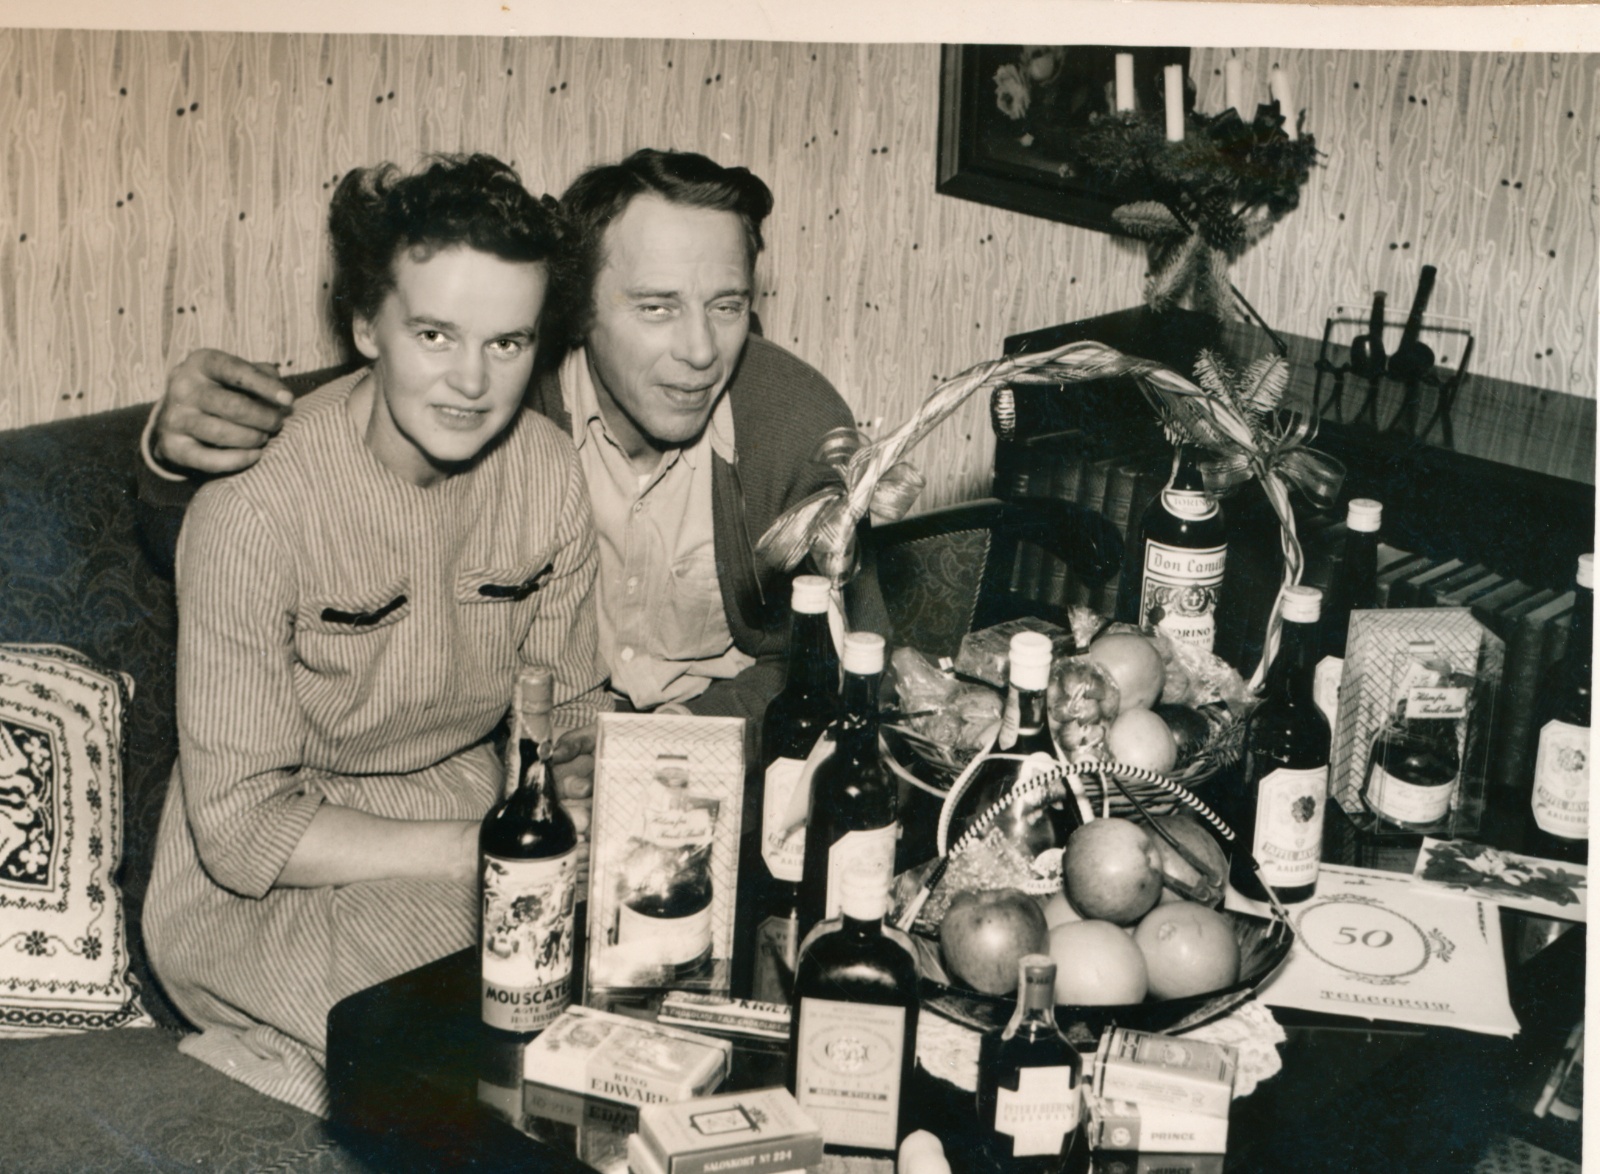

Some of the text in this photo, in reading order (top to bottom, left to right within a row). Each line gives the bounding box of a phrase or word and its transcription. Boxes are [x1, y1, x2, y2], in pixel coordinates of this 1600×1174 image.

[1154, 552, 1181, 572] Don
[1172, 627, 1211, 637] ORINO
[1333, 926, 1394, 948] 50
[486, 983, 571, 1005] MOUSCATE
[614, 1072, 648, 1088] KING
[1151, 1132, 1195, 1141] PRINCE
